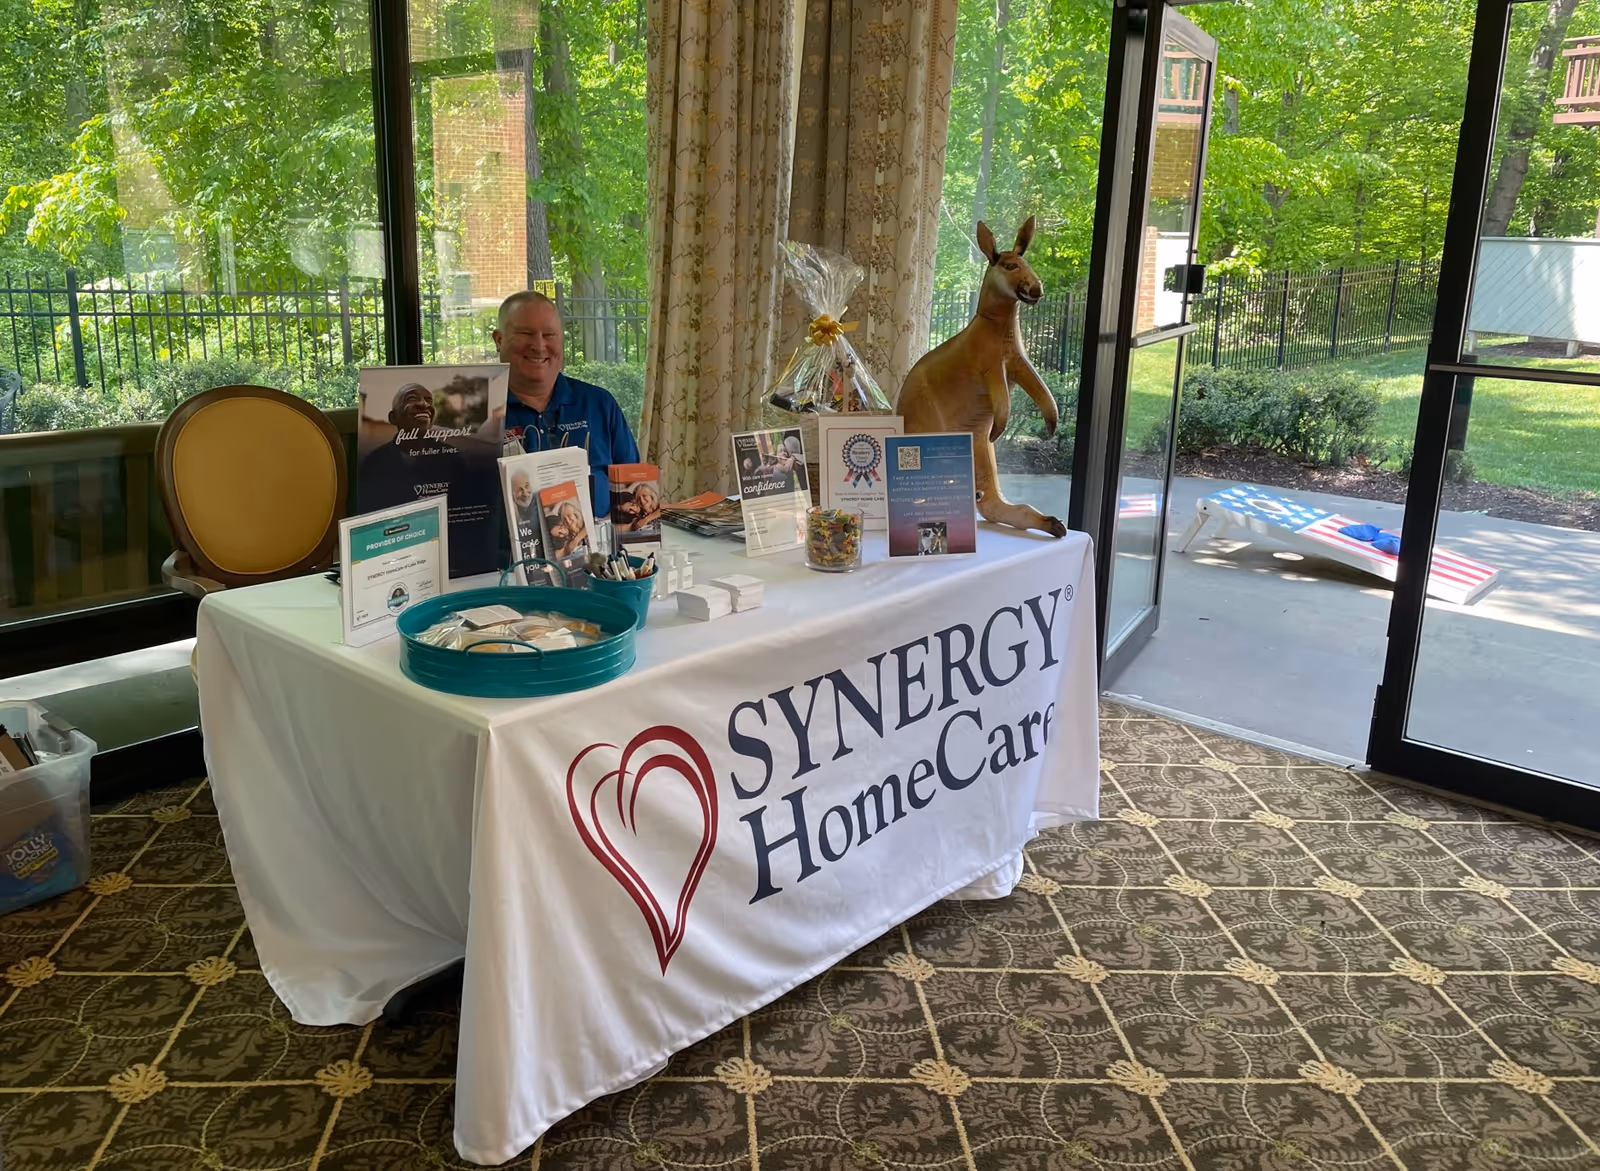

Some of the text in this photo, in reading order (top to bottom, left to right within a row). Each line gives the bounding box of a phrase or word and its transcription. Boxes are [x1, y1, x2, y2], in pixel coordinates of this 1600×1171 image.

[395, 426, 472, 445] full support
[744, 480, 786, 495] confidence
[366, 538, 396, 551] PROVIDER
[405, 529, 426, 540] CHOICE
[520, 528, 532, 536] We
[367, 571, 386, 580] SYNERGY
[526, 563, 540, 574] you
[6, 833, 46, 866] JOLLY
[12, 840, 53, 871] rancher
